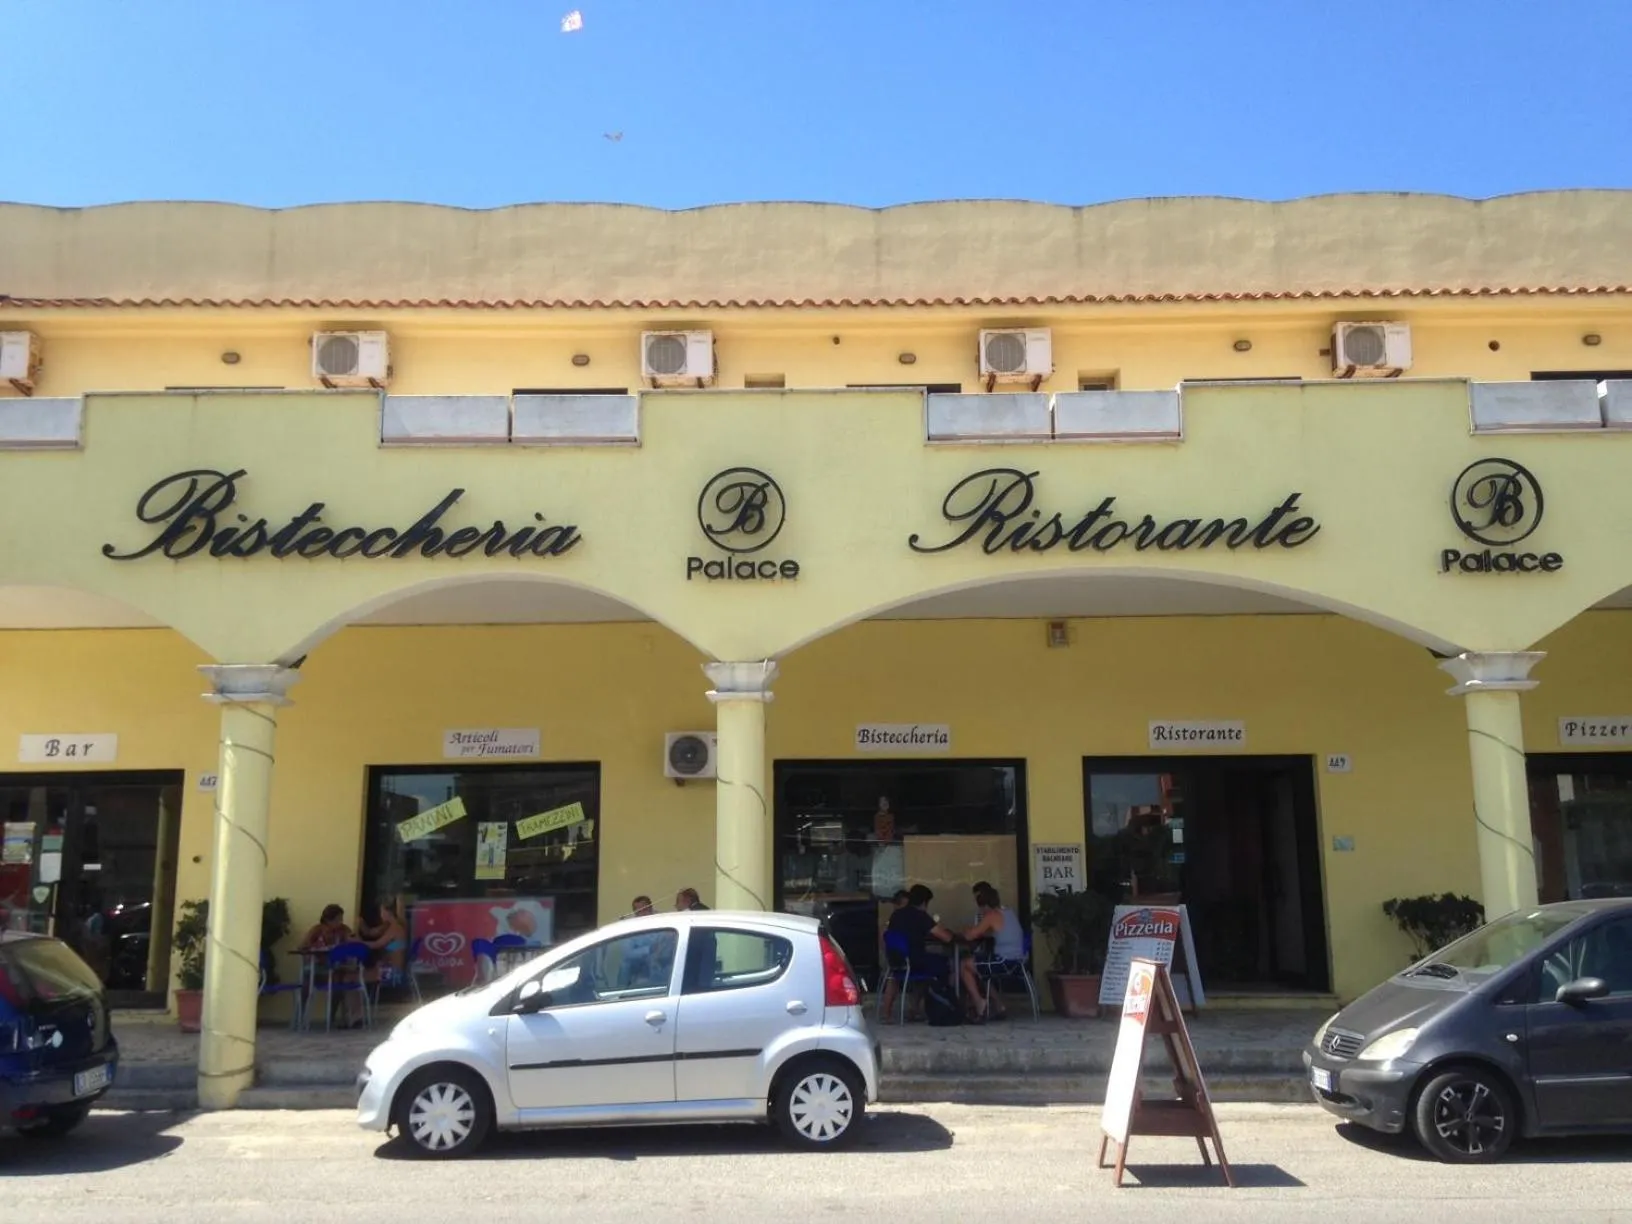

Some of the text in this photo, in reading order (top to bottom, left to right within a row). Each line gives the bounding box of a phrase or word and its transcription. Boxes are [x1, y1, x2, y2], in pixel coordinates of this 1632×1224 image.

[102, 468, 582, 560] Bisteccheria
[706, 481, 770, 535] B
[908, 467, 1321, 556] Ristorante
[686, 556, 800, 580] Palace
[1442, 548, 1564, 573] Palace
[449, 730, 499, 744] Articoli
[857, 725, 948, 744] Bisteccheria
[1153, 725, 1242, 741] Ristorante
[1565, 721, 1632, 737] Pizzer
[45, 738, 94, 757] Bar
[478, 742, 534, 757] Fumatori
[1043, 866, 1074, 879] BAR
[1115, 920, 1173, 936] Pizzeria
